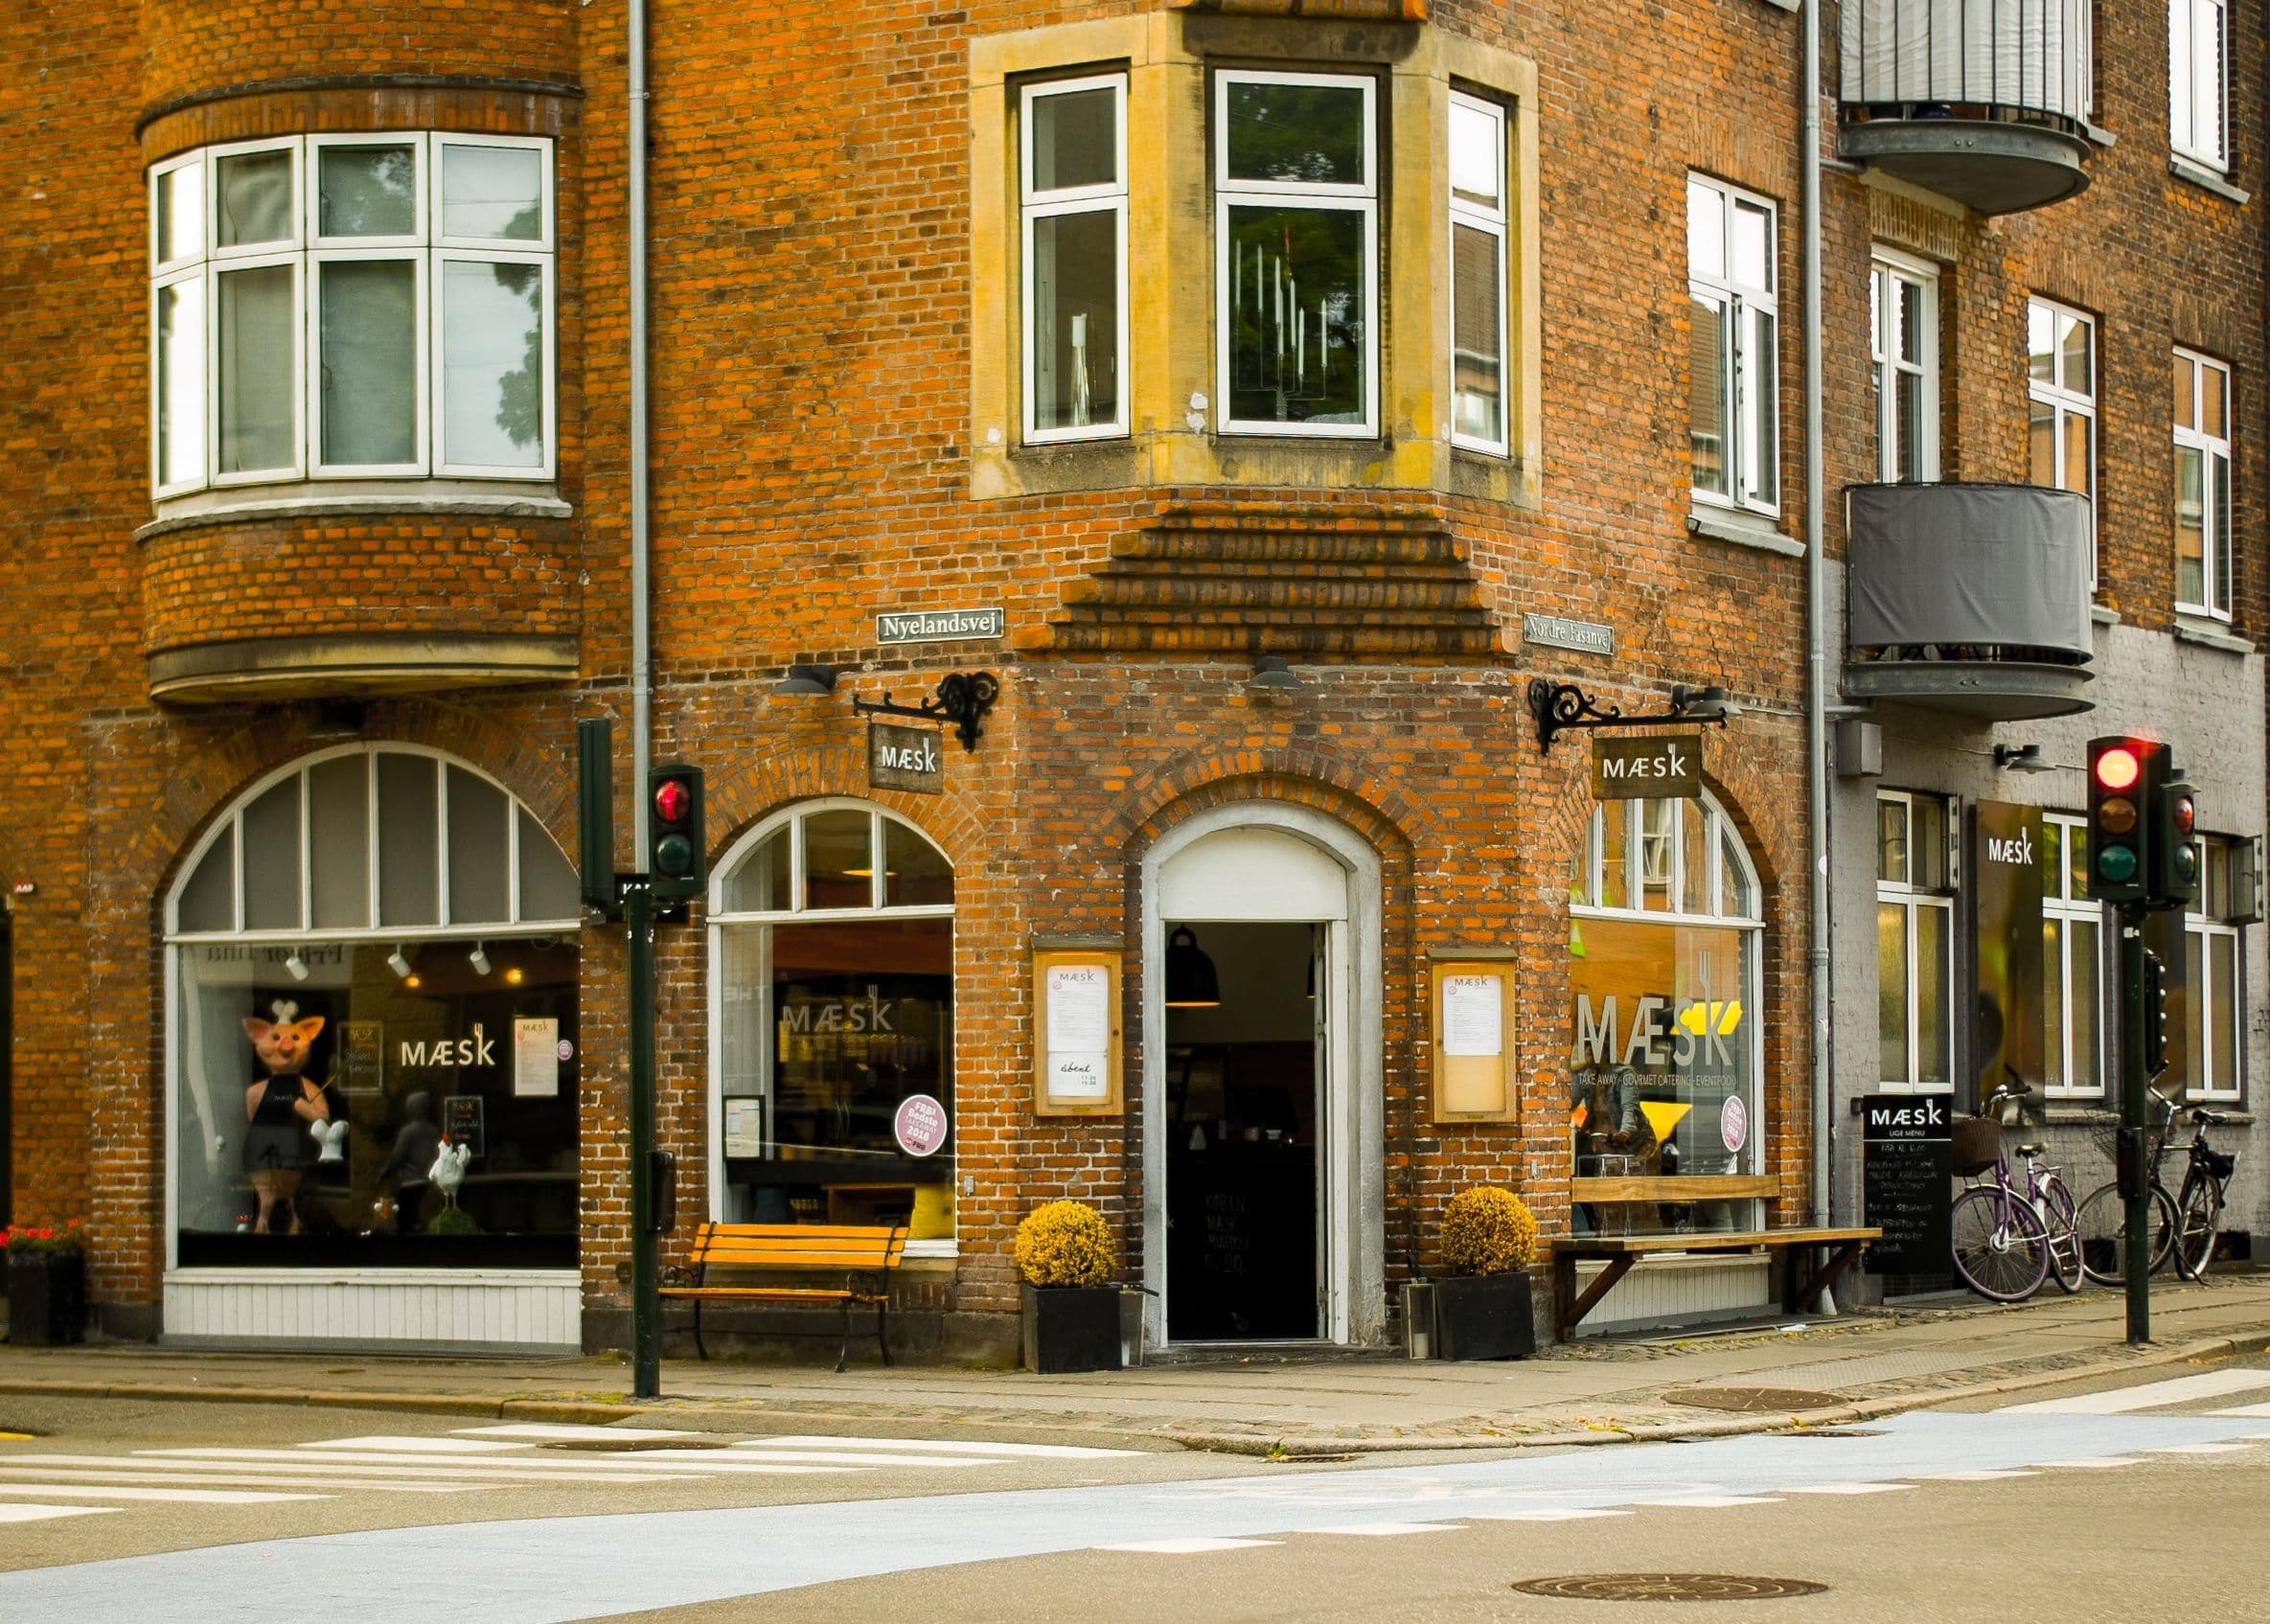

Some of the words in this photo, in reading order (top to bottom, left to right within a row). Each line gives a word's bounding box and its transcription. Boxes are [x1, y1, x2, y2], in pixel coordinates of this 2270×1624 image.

[883, 613, 996, 639] Nyelandsvej
[1528, 617, 1566, 639] Nordre
[882, 737, 936, 772] MÆSK
[1602, 743, 1686, 778] MÆSK
[1988, 826, 2032, 864] MÆSK
[1059, 969, 1094, 981] MÆSK
[1454, 975, 1488, 986] MÆSK
[783, 984, 893, 1032] MÆSK
[1576, 950, 1732, 1066] MÆSK
[401, 1022, 495, 1066] MÆSK
[1578, 1074, 1596, 1085] TAKE
[1597, 1074, 1617, 1085] AWAY
[1622, 1074, 1658, 1086] GOURMET
[1658, 1074, 1691, 1086] CATERING
[1695, 1075, 1737, 1086] EVENTFOOD
[1871, 1098, 1943, 1126] MÆSK
[906, 1125, 929, 1141] 2018
